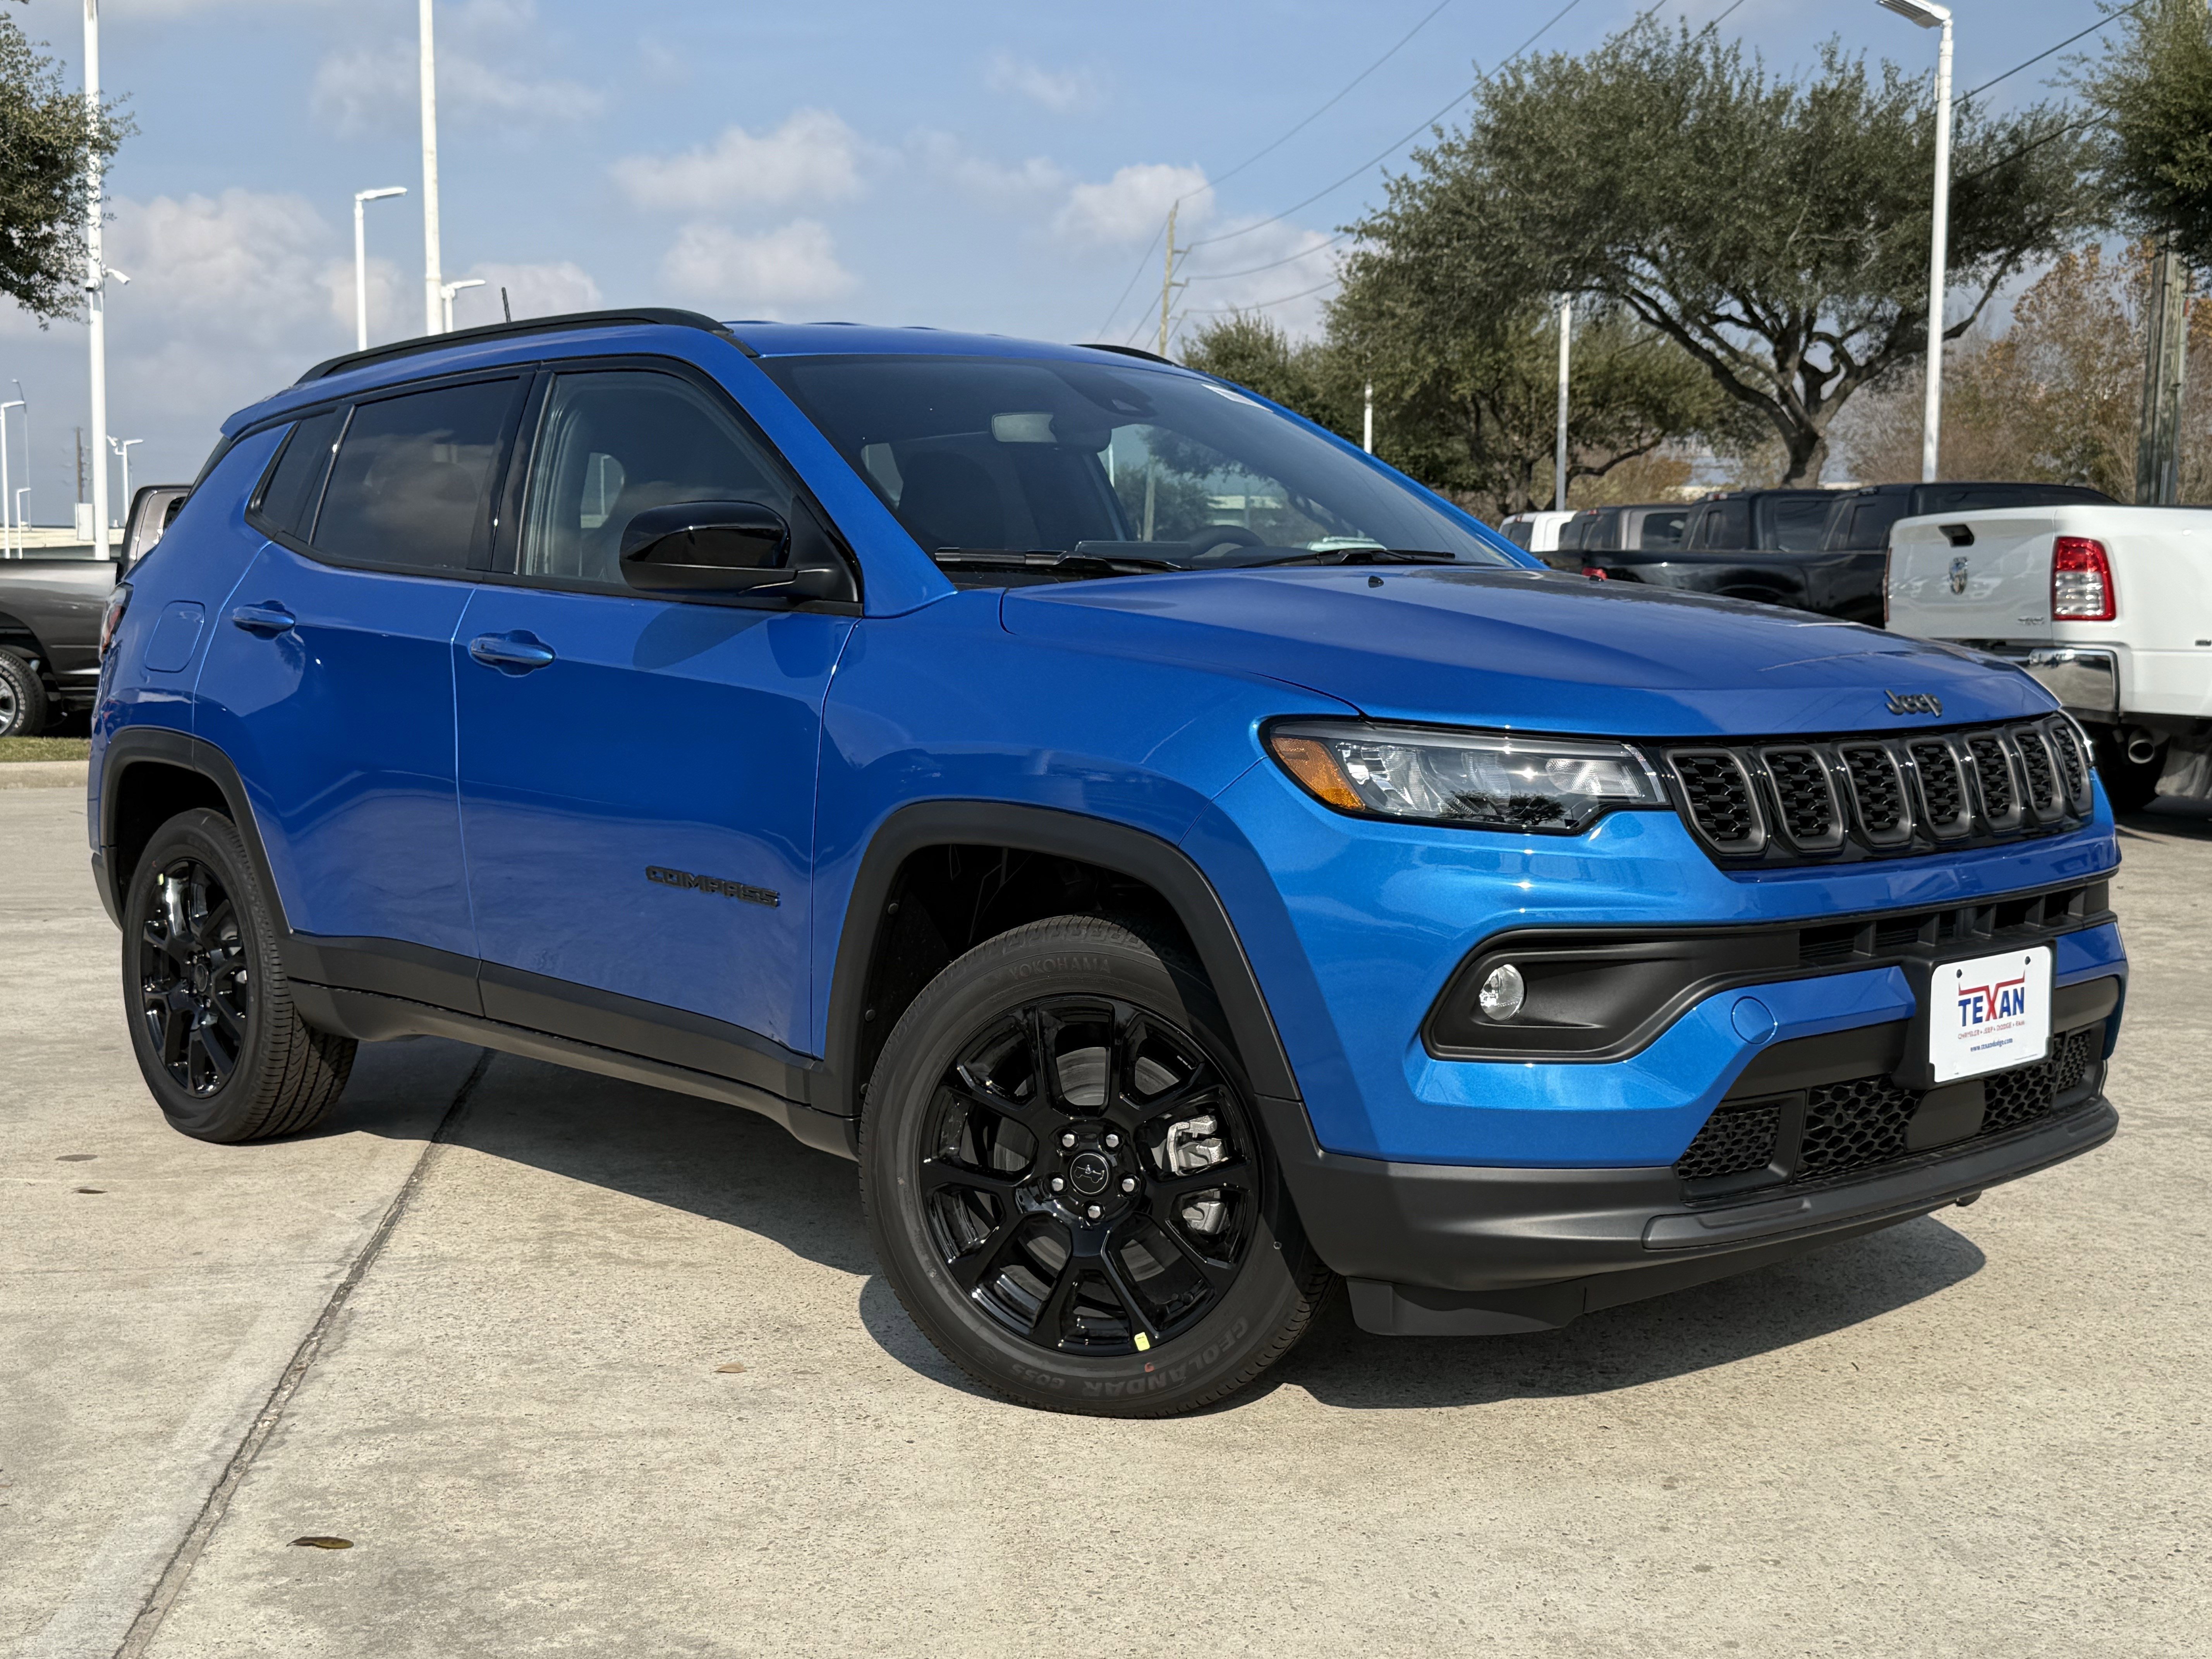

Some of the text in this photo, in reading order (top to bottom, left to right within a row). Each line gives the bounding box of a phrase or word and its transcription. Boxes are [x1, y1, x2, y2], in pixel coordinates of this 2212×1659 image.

[1884, 689, 1942, 718] Jeep
[646, 866, 780, 908] COMPASS
[1009, 957, 1111, 980] YOKOHAMA
[1958, 970, 2025, 1027] TEXAN
[1082, 1316, 1249, 1397] GEOLANDAR
